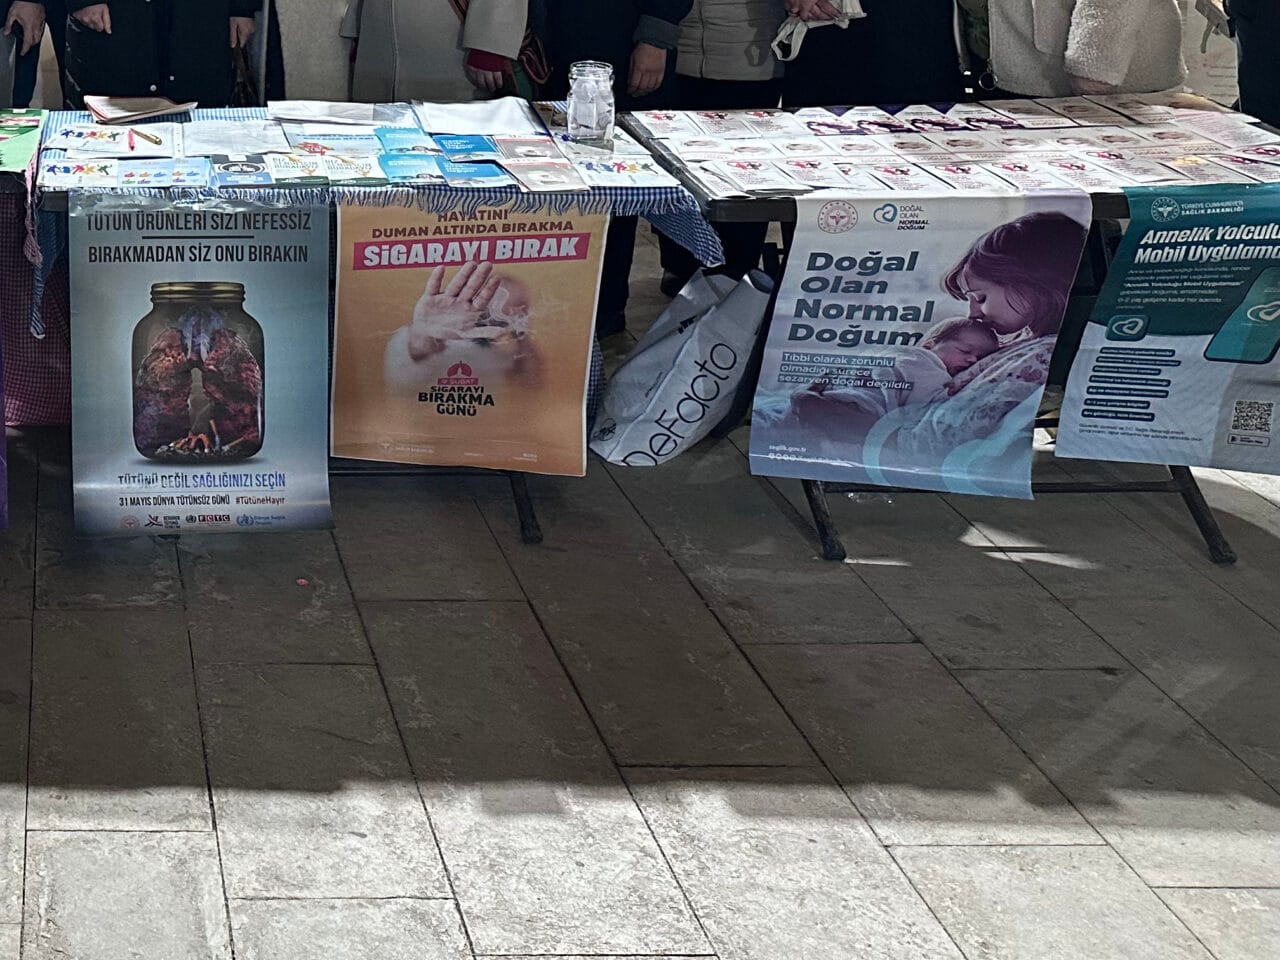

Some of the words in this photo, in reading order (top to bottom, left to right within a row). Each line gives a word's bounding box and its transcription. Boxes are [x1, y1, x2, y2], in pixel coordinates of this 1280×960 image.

[86, 211, 132, 231] TÜTÜN
[242, 209, 311, 230] NEFESSİZ
[372, 225, 429, 238] DUMAN
[433, 223, 498, 236] ALTINDA
[502, 220, 574, 233] BIRAKMA
[1140, 227, 1214, 245] Annelik
[88, 246, 185, 263] BIRAKMADAN
[189, 242, 211, 262] SİZ
[215, 245, 244, 262] ONU
[249, 244, 308, 262] BIRAKIN
[494, 236, 579, 260] BIRAK
[1134, 246, 1187, 264] Mobil
[806, 251, 919, 276] Doğal
[800, 276, 888, 294] Olan
[794, 299, 935, 323] Normal
[788, 324, 924, 348] Doğum
[813, 355, 848, 365] olarak
[851, 357, 895, 367] zorunlu
[418, 392, 495, 407] BIRAKMA
[436, 403, 477, 417] GÜNÜ
[160, 472, 190, 488] DEĞİL
[192, 472, 253, 488] SAĞLIĞINIZI
[255, 471, 286, 490] SEÇİN
[119, 496, 128, 507] 31
[130, 496, 152, 506] MAYIS
[153, 494, 175, 506] DÜNYA
[212, 493, 230, 505] GÜNÜ
